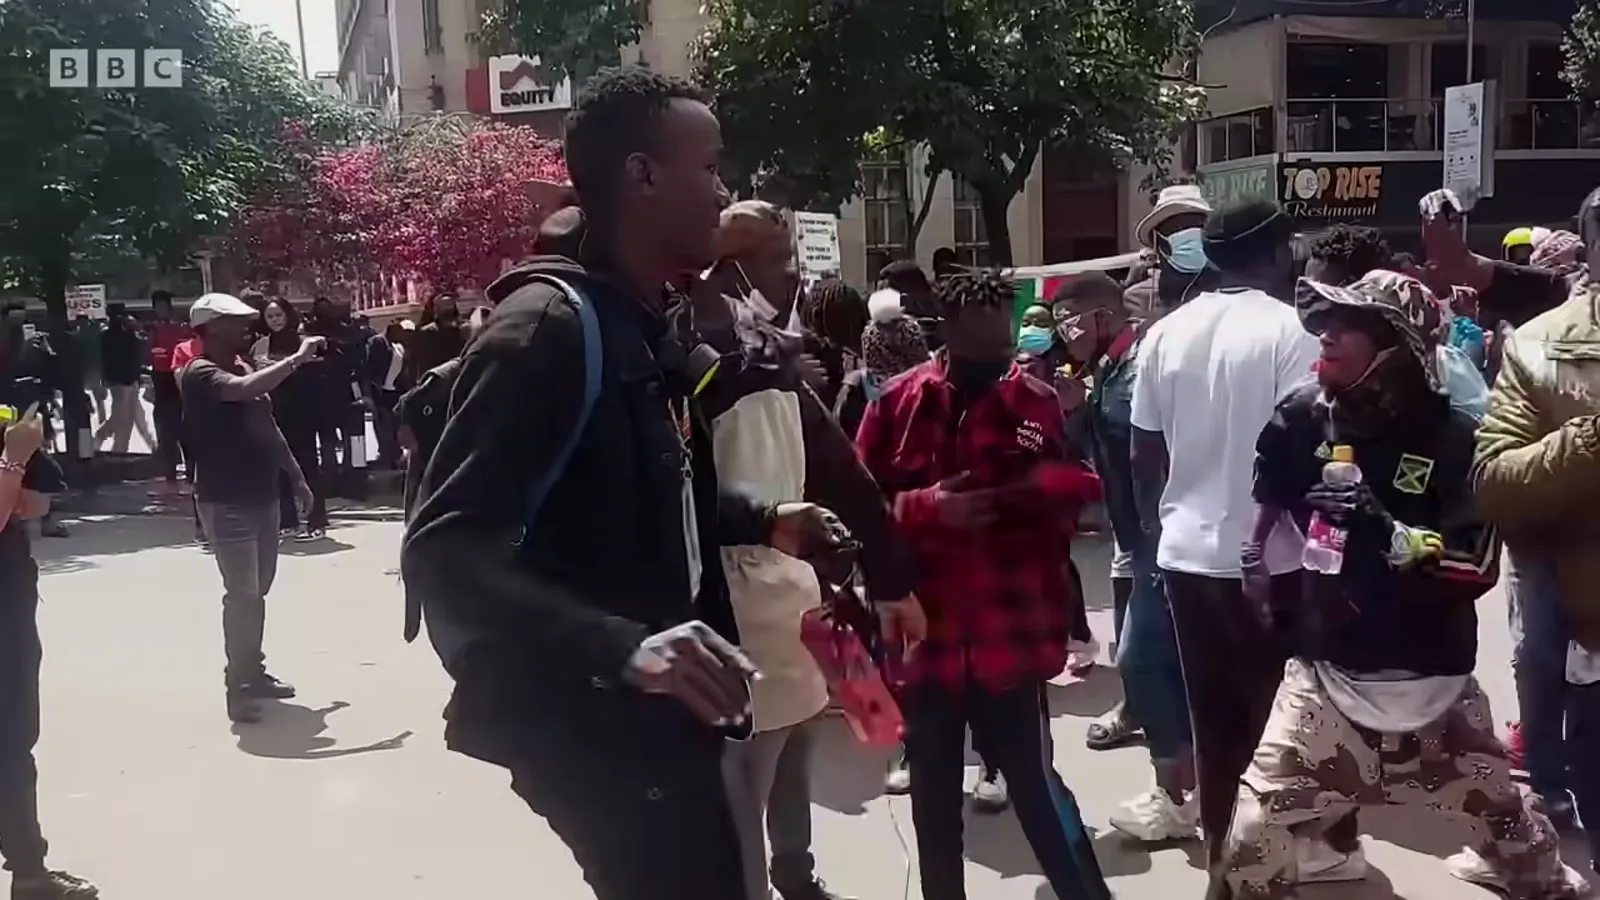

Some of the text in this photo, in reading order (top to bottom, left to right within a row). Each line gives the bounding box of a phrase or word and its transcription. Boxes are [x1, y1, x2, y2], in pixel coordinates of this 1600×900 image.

[500, 89, 556, 107] EQUITY
[1284, 166, 1382, 201] TOP RISE
[1284, 201, 1377, 219] Restaurant
